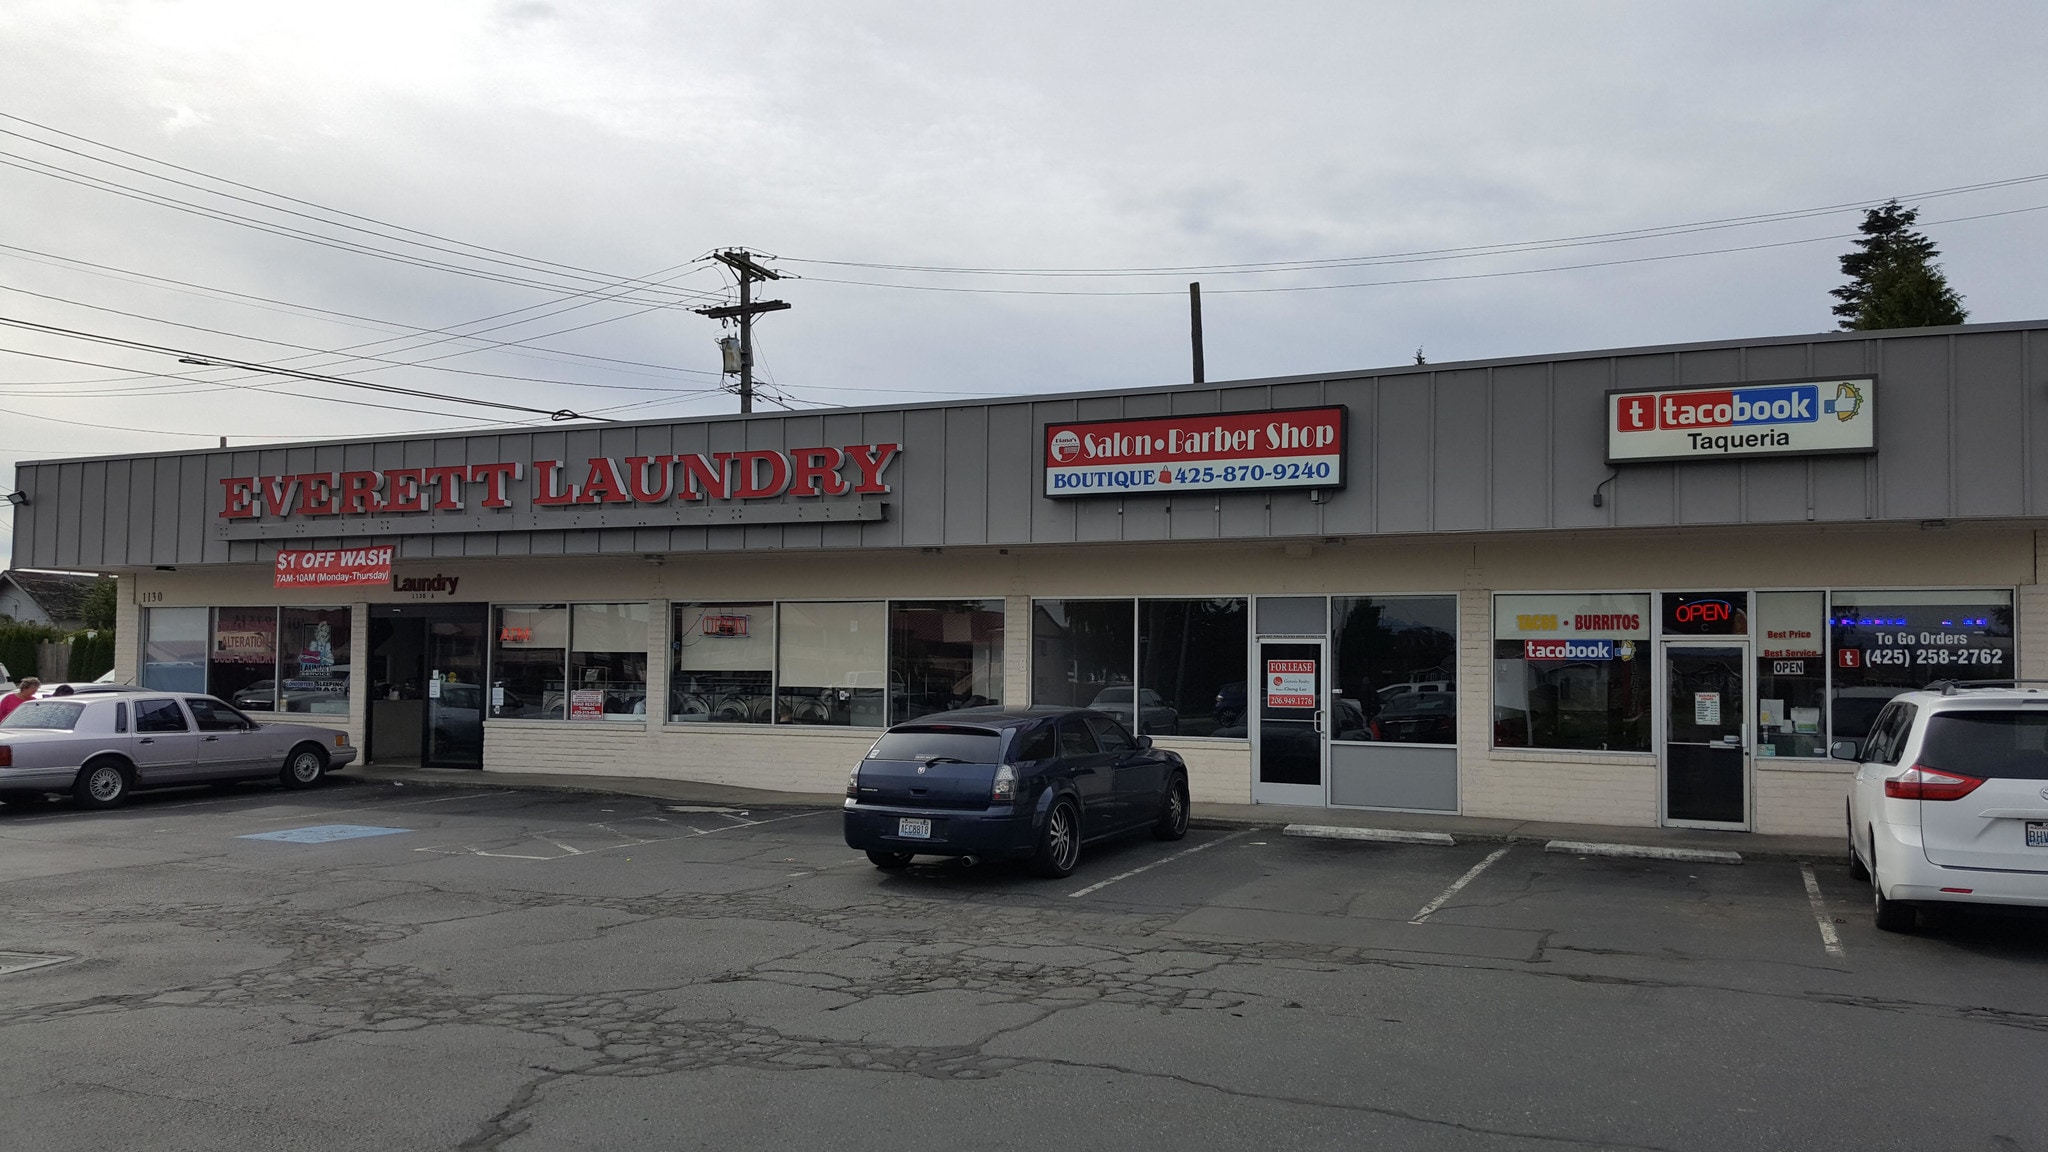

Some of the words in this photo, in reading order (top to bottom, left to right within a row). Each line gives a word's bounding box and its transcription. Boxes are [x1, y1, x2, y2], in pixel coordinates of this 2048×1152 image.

[1663, 391, 1811, 425] tacobook
[1083, 432, 1151, 459] Salon
[1168, 426, 1260, 454] Barber
[1266, 422, 1334, 449] Shop
[1687, 429, 1790, 452] Taqueria
[219, 462, 523, 517] EVERETT
[533, 443, 902, 505] LAUNDRY
[1054, 470, 1156, 489] BOUTIQUE
[1174, 461, 1331, 484] 425-870-9240
[277, 553, 297, 570] $1
[301, 552, 335, 569] OFF
[340, 549, 392, 567] WASH
[276, 573, 316, 583] 7AM-10AM
[317, 570, 389, 583] (Monday-Thursday)
[393, 574, 460, 596] Laundry
[143, 591, 163, 602] 1130
[1676, 603, 1729, 623] OPEN
[1517, 614, 1558, 631] TACOS
[1574, 614, 1640, 631] BURRITOS
[1767, 631, 1787, 639] Best
[1789, 630, 1812, 638] Price
[1876, 632, 1893, 645] To
[1897, 632, 1916, 645] Go
[1920, 631, 1968, 645] Orders
[1527, 641, 1610, 658] tacobook
[1764, 649, 1783, 657] Best
[1785, 649, 1817, 657] Service
[1865, 649, 1911, 667] (425)
[1916, 649, 2003, 665] 258-2762
[1270, 662, 1287, 672] FOR
[1288, 662, 1313, 672] LEASE
[1774, 662, 1803, 673] OPEN
